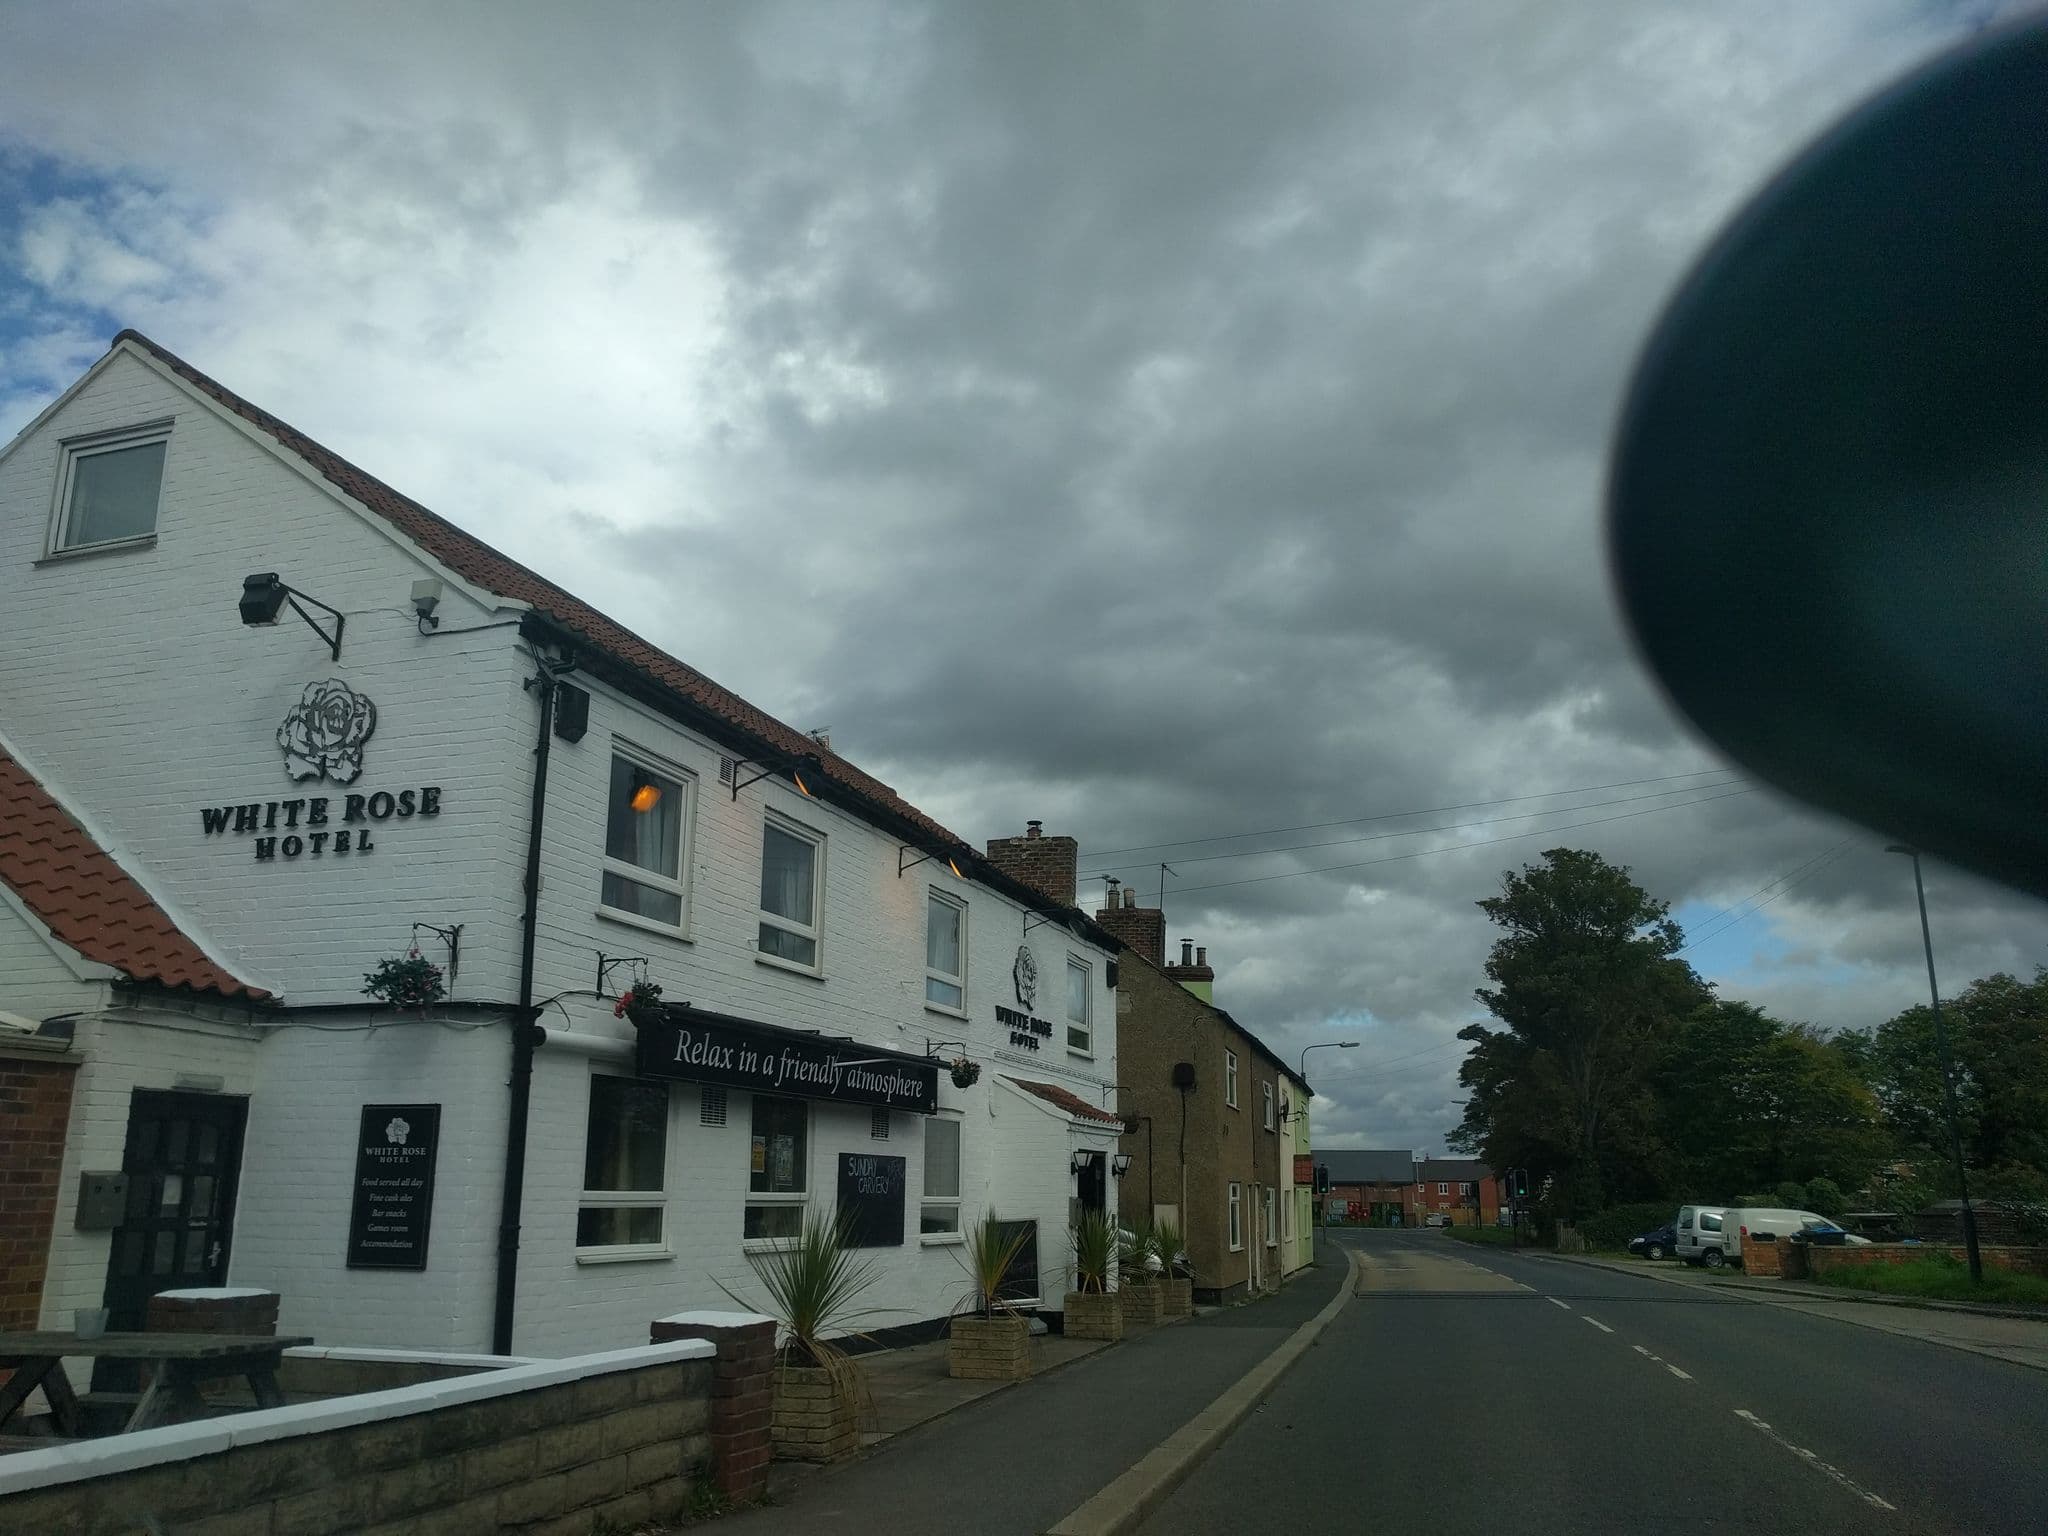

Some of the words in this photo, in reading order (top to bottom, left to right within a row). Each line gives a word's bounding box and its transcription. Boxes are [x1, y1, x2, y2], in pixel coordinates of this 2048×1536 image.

[200, 797, 329, 834] WHITE
[342, 786, 441, 823] ROSE
[254, 829, 374, 859] HOTEL
[995, 1005, 1029, 1030] WHITE
[673, 1029, 733, 1070] Relax
[739, 1042, 757, 1073] in
[762, 1054, 774, 1076] a
[775, 1047, 843, 1094] friendly
[847, 1068, 922, 1102] atmosphere
[365, 1147, 399, 1156] WHITE
[402, 1147, 427, 1156] ROSE
[848, 1157, 878, 1177] SUNDAY
[362, 1178, 378, 1187] Food
[379, 1178, 400, 1186] served
[401, 1178, 411, 1186] all
[411, 1178, 424, 1189] day
[858, 1176, 889, 1194] CARVERY
[369, 1193, 384, 1202] Fine
[384, 1193, 399, 1201] cask
[372, 1209, 384, 1217] Bar
[386, 1209, 407, 1217] snacks
[367, 1223, 389, 1232] Games
[360, 1240, 413, 1248] Accommodation
